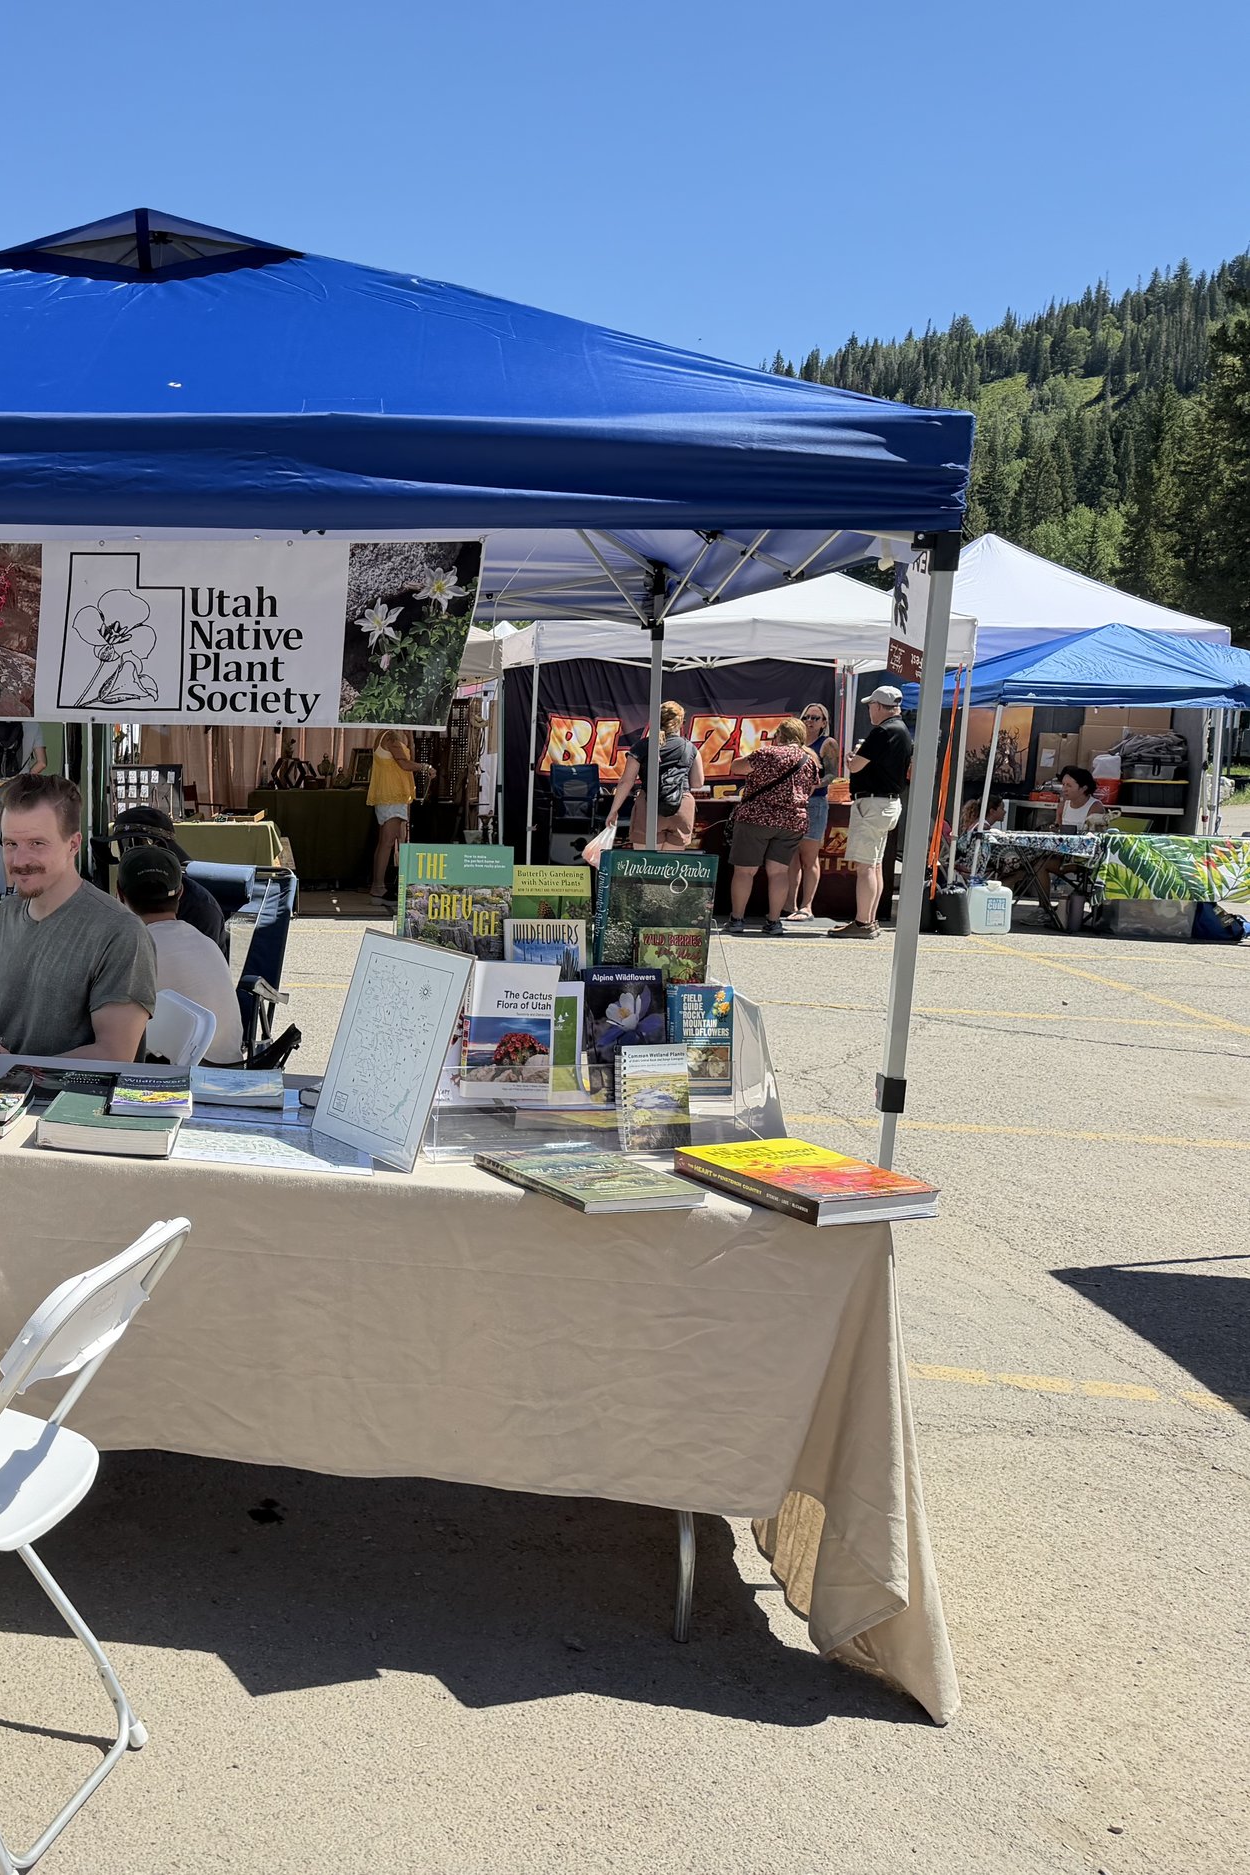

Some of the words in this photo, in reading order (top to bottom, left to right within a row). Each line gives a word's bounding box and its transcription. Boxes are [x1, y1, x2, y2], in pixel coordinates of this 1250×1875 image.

[190, 586, 278, 618] Utah
[188, 620, 304, 651] Native
[187, 653, 286, 683] Plant
[185, 684, 321, 723] Society
[538, 714, 792, 779] BLZE
[415, 852, 448, 880] THE
[517, 869, 547, 879] Butterfly
[549, 870, 584, 880] Gardening
[623, 857, 680, 879] Undaunted
[669, 861, 711, 894] garden
[521, 878, 537, 886] with
[538, 878, 560, 886] Native
[561, 879, 581, 887] Plants
[427, 893, 473, 921] CREV
[512, 923, 579, 945] WILDFLOWERS
[642, 933, 665, 945] WILD
[668, 934, 703, 947] BERRIES
[592, 973, 614, 983] Alpine
[615, 973, 656, 981] Wildflowers
[504, 990, 520, 1000] The
[522, 990, 553, 1000] Cactus
[683, 993, 703, 1002] FIELD
[496, 1000, 518, 1009] Flora
[520, 1000, 529, 1009] of
[531, 1001, 552, 1010] Utah
[682, 1002, 704, 1011] GUIDE
[682, 1010, 705, 1019] ROCKY
[682, 1019, 718, 1028] MOUNTAIN
[682, 1027, 730, 1037] WILDFLOWERS
[705, 1146, 773, 1157] HEART
[693, 1165, 713, 1177] HEART
